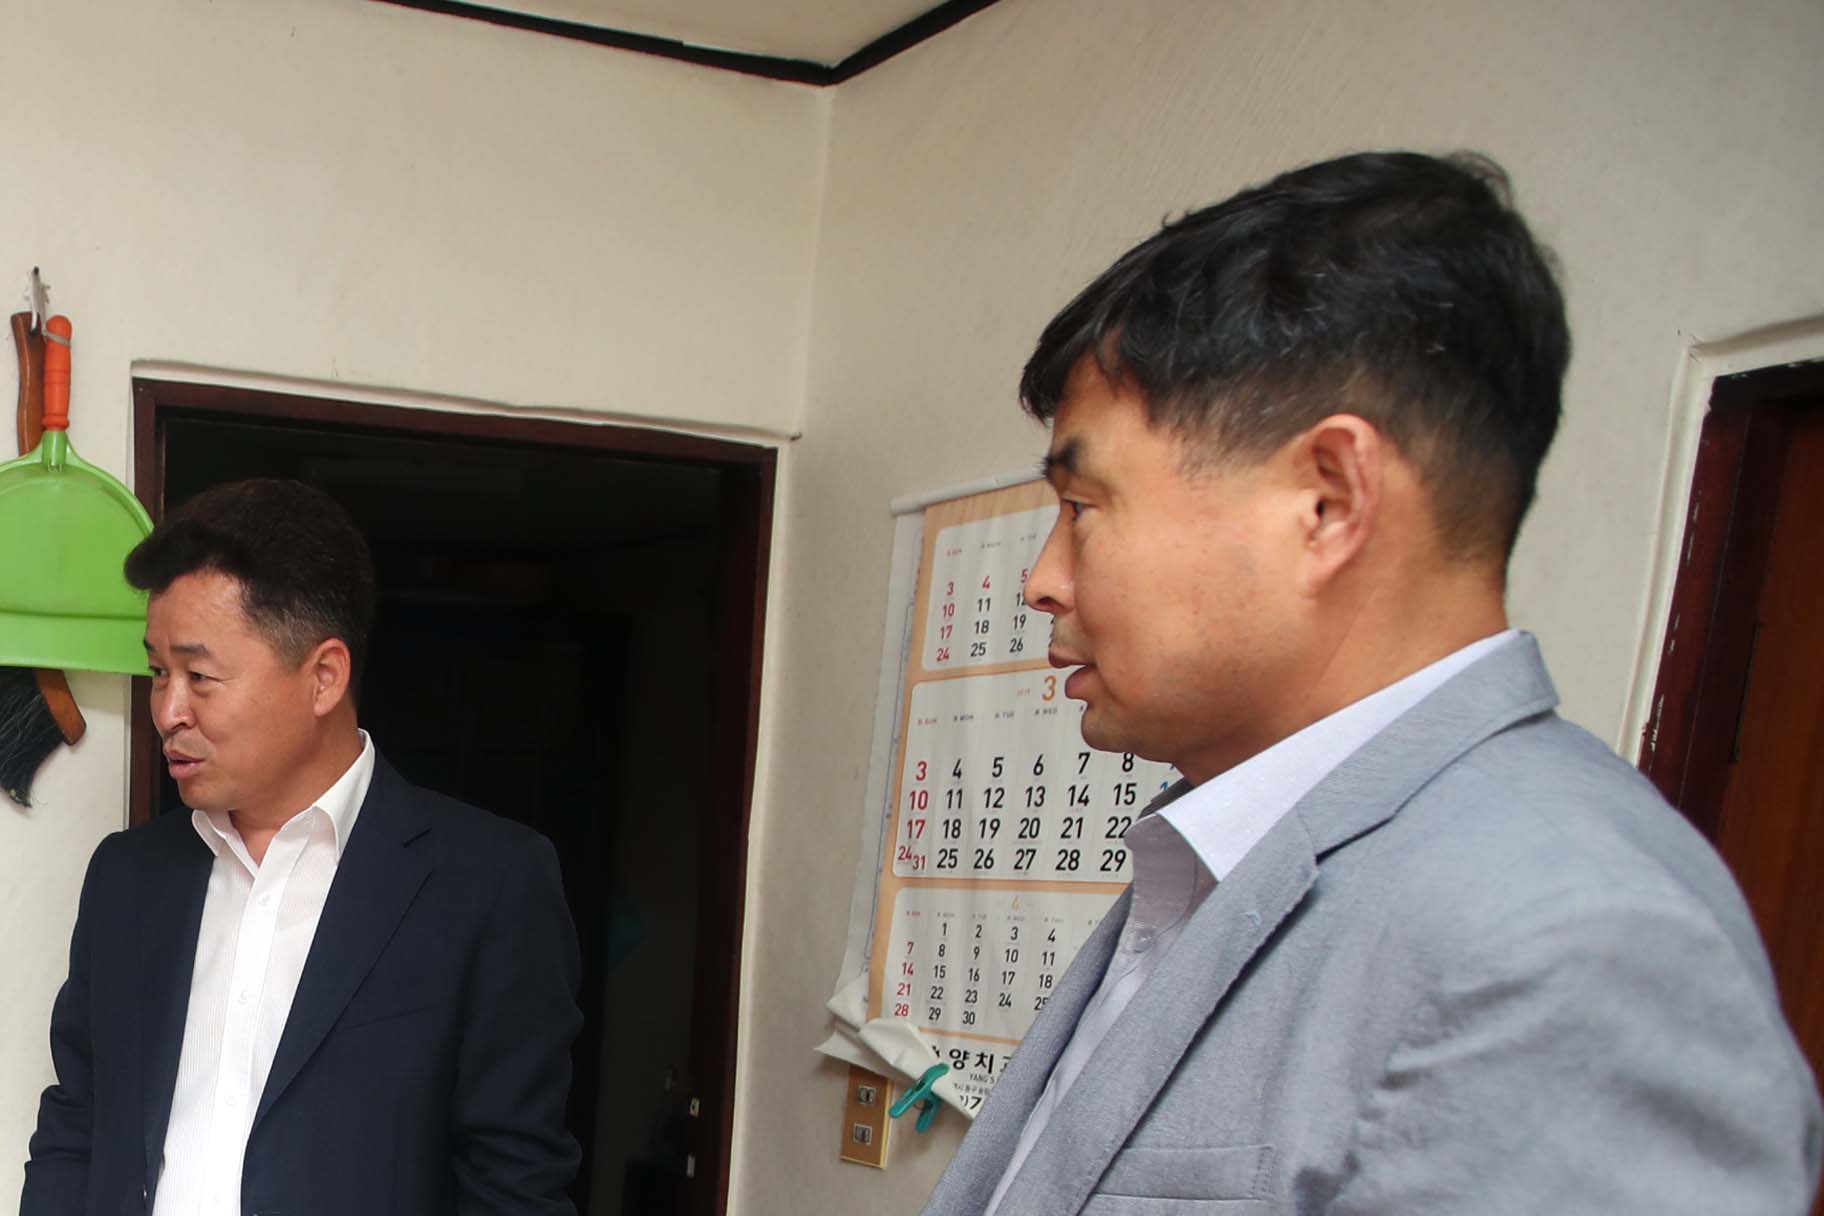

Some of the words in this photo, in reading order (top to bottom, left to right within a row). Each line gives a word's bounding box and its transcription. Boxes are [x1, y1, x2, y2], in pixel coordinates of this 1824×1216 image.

[947, 582, 954, 596] 3
[982, 576, 991, 589] 4
[1021, 568, 1029, 583] 5
[943, 603, 955, 618] 10
[977, 598, 991, 612] 11
[940, 625, 952, 640] 17
[976, 620, 990, 634] 18
[1014, 614, 1027, 630] 19
[937, 647, 950, 662] 24
[971, 642, 987, 657] 25
[1009, 637, 1024, 653] 26
[1042, 675, 1056, 701] 3
[916, 760, 927, 781] 3
[952, 758, 962, 779] 4
[992, 757, 1004, 778] 5
[1033, 754, 1044, 776] 6
[1078, 752, 1090, 774] 7
[1122, 751, 1134, 773] 8
[910, 790, 928, 811] 10
[946, 788, 963, 809] 11
[984, 787, 1005, 808] 12
[1026, 785, 1046, 807] 13
[1068, 784, 1090, 807] 14
[1113, 782, 1137, 806] 15
[907, 819, 926, 839] 17
[943, 818, 961, 839] 18
[979, 818, 1000, 839] 19
[1018, 817, 1041, 839] 20
[1060, 817, 1084, 839] 21
[1105, 816, 1132, 839] 22
[898, 845, 912, 861] 24
[912, 855, 926, 870] 31
[937, 848, 959, 869] 25
[974, 848, 994, 869] 26
[1014, 848, 1037, 870] 27
[1056, 848, 1081, 871] 28
[1100, 849, 1127, 872] 29
[942, 922, 947, 936] 1
[976, 924, 983, 938] 2
[1010, 926, 1019, 941] 3
[1047, 928, 1056, 943] 4
[907, 941, 914, 955] 7
[938, 943, 946, 957] 8
[973, 946, 980, 960] 9
[1005, 948, 1019, 963] 10
[1042, 951, 1055, 967] 11
[902, 962, 914, 976] 14
[934, 965, 946, 979] 15
[969, 967, 980, 982] 16
[1002, 970, 1016, 986] 17
[1039, 973, 1053, 989] 18
[896, 982, 911, 997] 21
[930, 986, 944, 1000] 22
[964, 989, 978, 1004] 23
[998, 992, 1012, 1008] 24
[894, 1003, 909, 1017] 28
[928, 1007, 941, 1022] 29
[962, 1011, 976, 1025] 30
